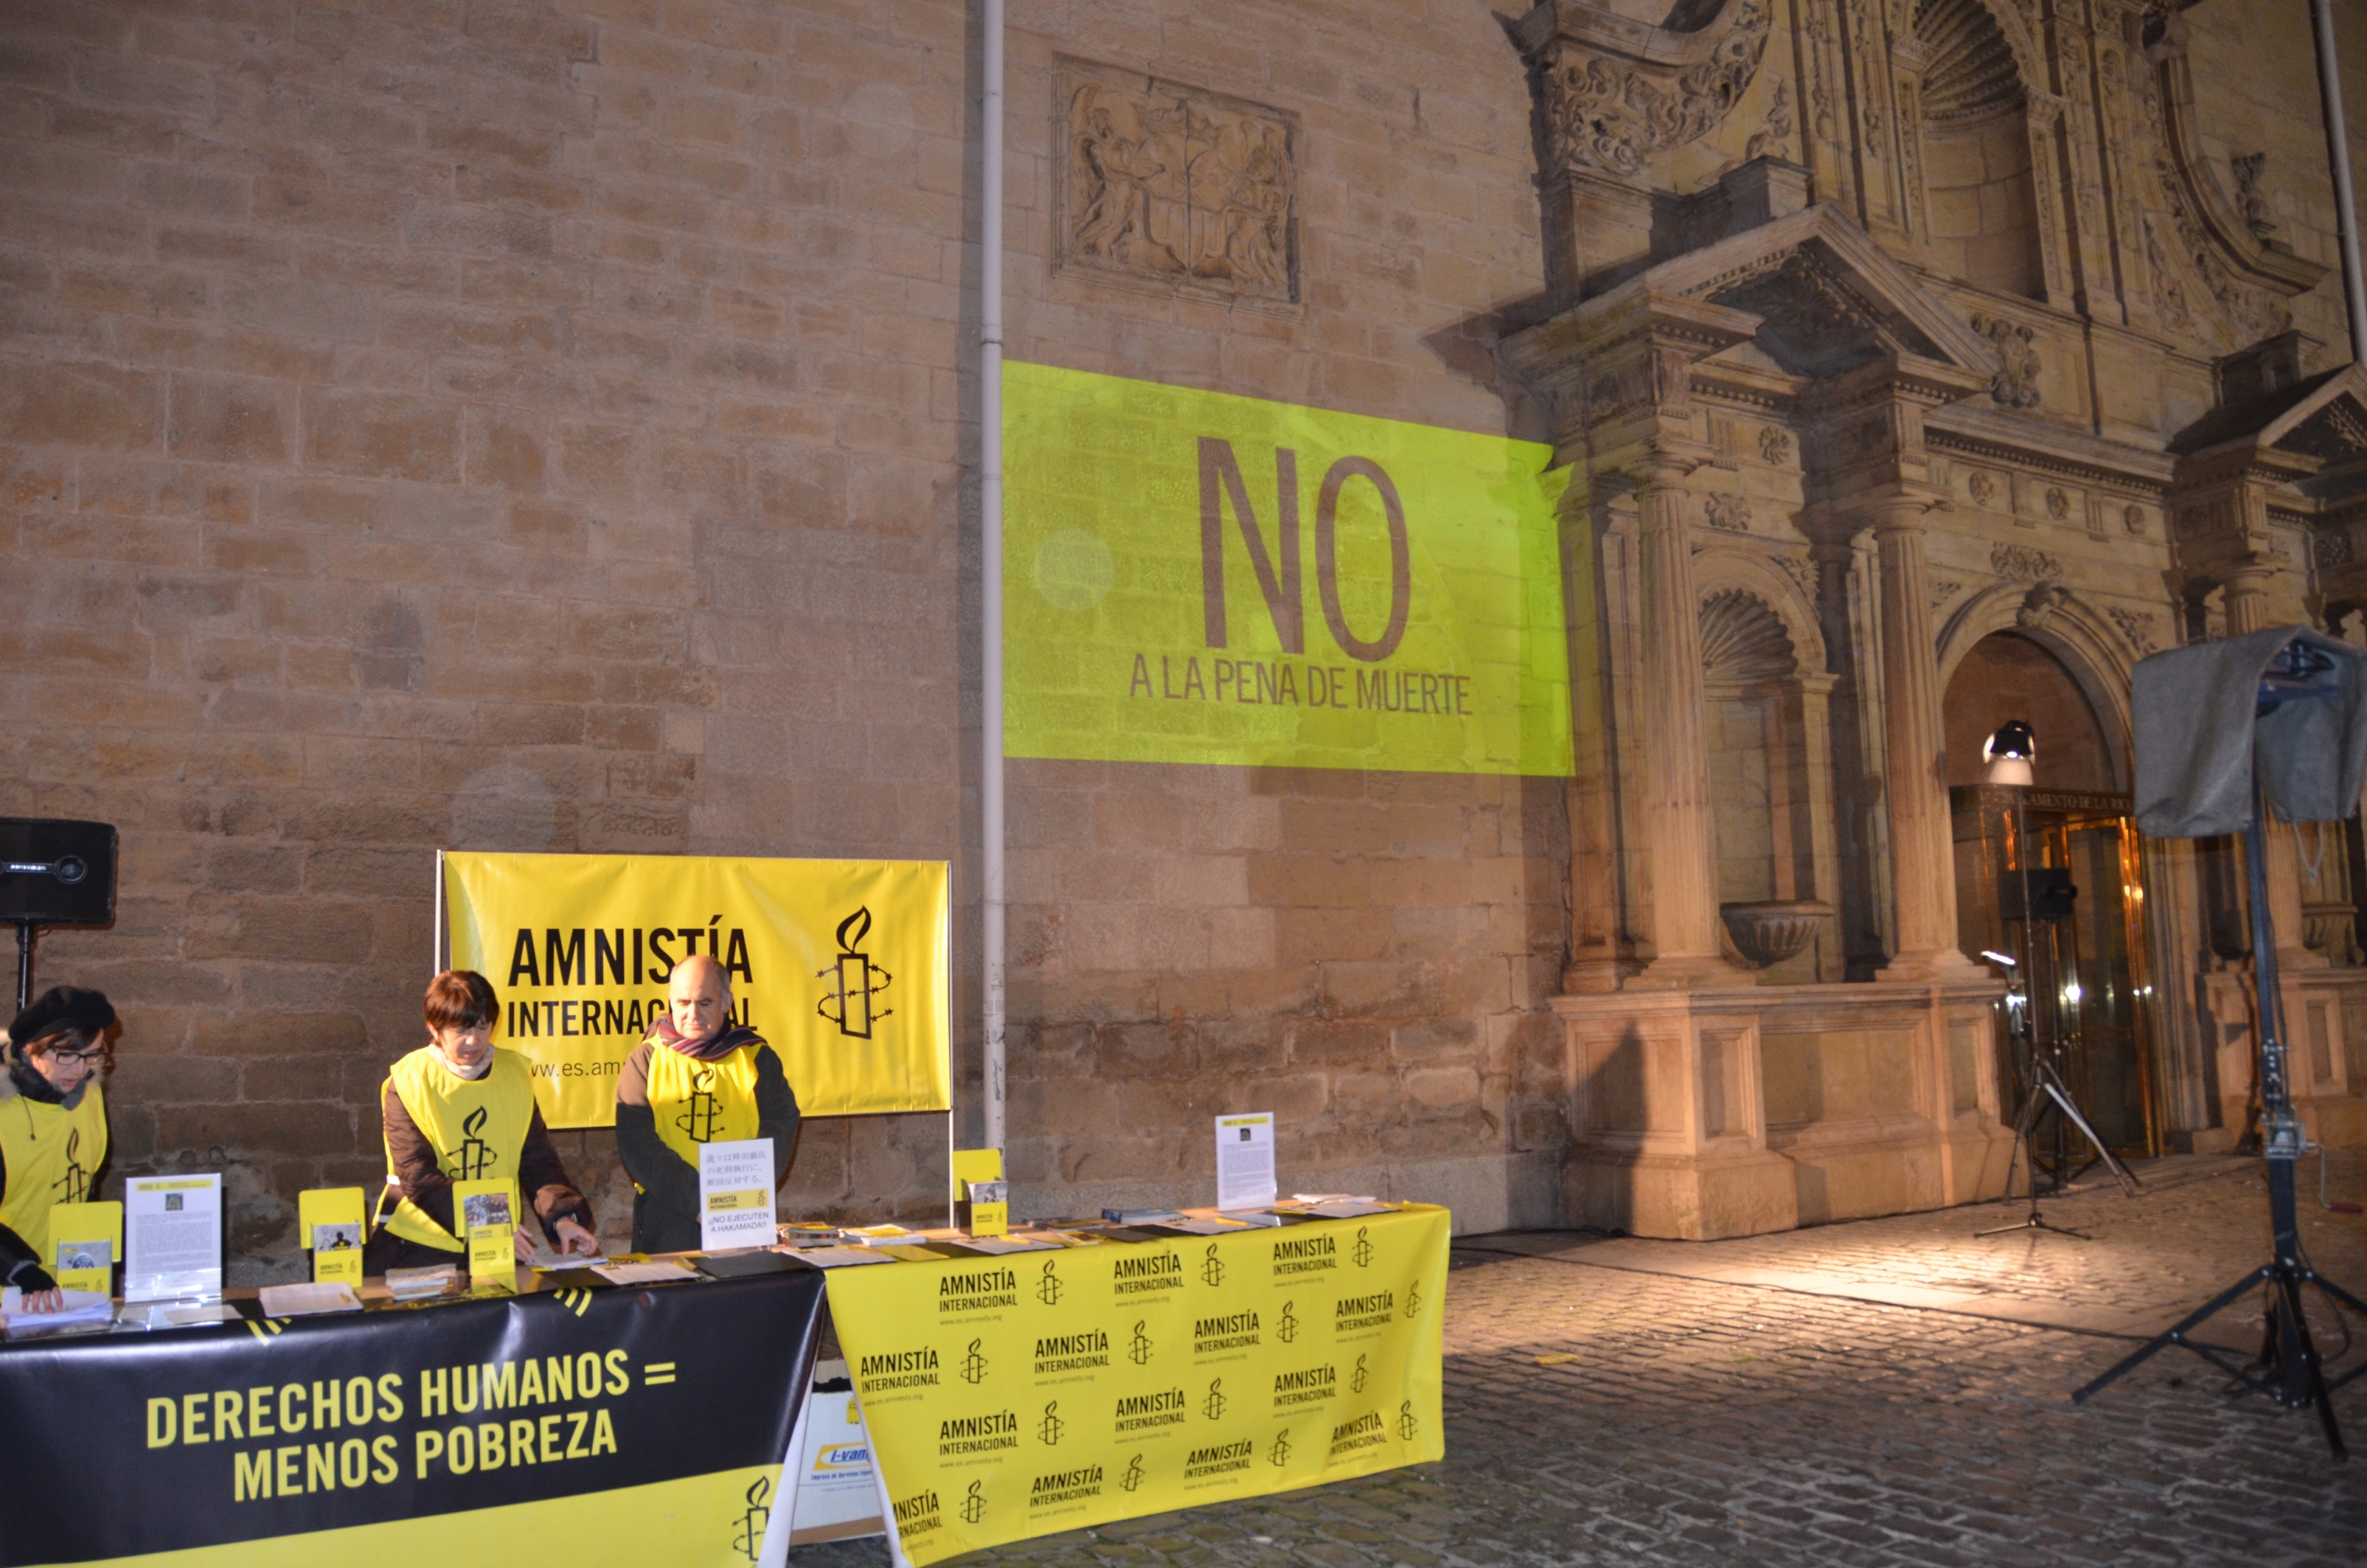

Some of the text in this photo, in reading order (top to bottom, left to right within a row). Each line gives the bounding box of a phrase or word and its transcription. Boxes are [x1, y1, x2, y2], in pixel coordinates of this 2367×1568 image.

[1197, 435, 1411, 662] NO
[1129, 653, 1473, 715] A LA PENA DE MUERTE
[507, 914, 753, 987] AMNISTÍA
[508, 997, 758, 1038] INTERNACAL
[710, 1194, 737, 1204] AMNISTÍA
[718, 1221, 766, 1232] HAKAMADA!!
[727, 1212, 769, 1222] EJECUTEN
[1274, 1233, 1336, 1261] AMNISTÍA
[1114, 1250, 1182, 1279] AMNISTÍA
[1274, 1257, 1337, 1275] INTERNACIONAL
[940, 1266, 1016, 1297] AMNISTÍA
[1114, 1276, 1184, 1295] INTERNACIONAL
[940, 1294, 1017, 1312] INTERNACIONAL
[1336, 1289, 1393, 1318] AMNISTÍA
[940, 1314, 1002, 1326] www.es.amnesty.org
[1195, 1309, 1259, 1338] AMNISTÍA
[1336, 1313, 1392, 1332] INTERNACIONAL
[1035, 1328, 1108, 1358] AMNISTÍA
[1194, 1334, 1261, 1354] INTERNACIONAL
[861, 1347, 938, 1377] AMNISTÍA
[1035, 1355, 1110, 1374] INTERNACIONAL
[862, 1373, 940, 1394] INTERNACIONAL
[1274, 1363, 1336, 1393] AMNISTÍA
[147, 1349, 675, 1449] DERECHOS HUMANOS =
[1116, 1387, 1185, 1418] AMNISTÍA
[1274, 1387, 1336, 1407] INTERNACIONAL
[940, 1409, 1017, 1440] AMNISTÍA
[1115, 1412, 1185, 1433] INTERNACIONAL
[1332, 1410, 1384, 1443] AMNISTÍA
[234, 1409, 617, 1501] MENOS POBREZA
[940, 1436, 1019, 1456] INTERNACIONAL
[1187, 1438, 1252, 1466] AMNISTÍA
[1330, 1433, 1387, 1457] INTERNACIONAL
[940, 1456, 1003, 1469] www.es.amnesty.org
[1184, 1457, 1251, 1479] INTERNACIONAL
[1032, 1464, 1103, 1494] AMNISTÍA
[1030, 1485, 1101, 1508] INTERNACIONAL
